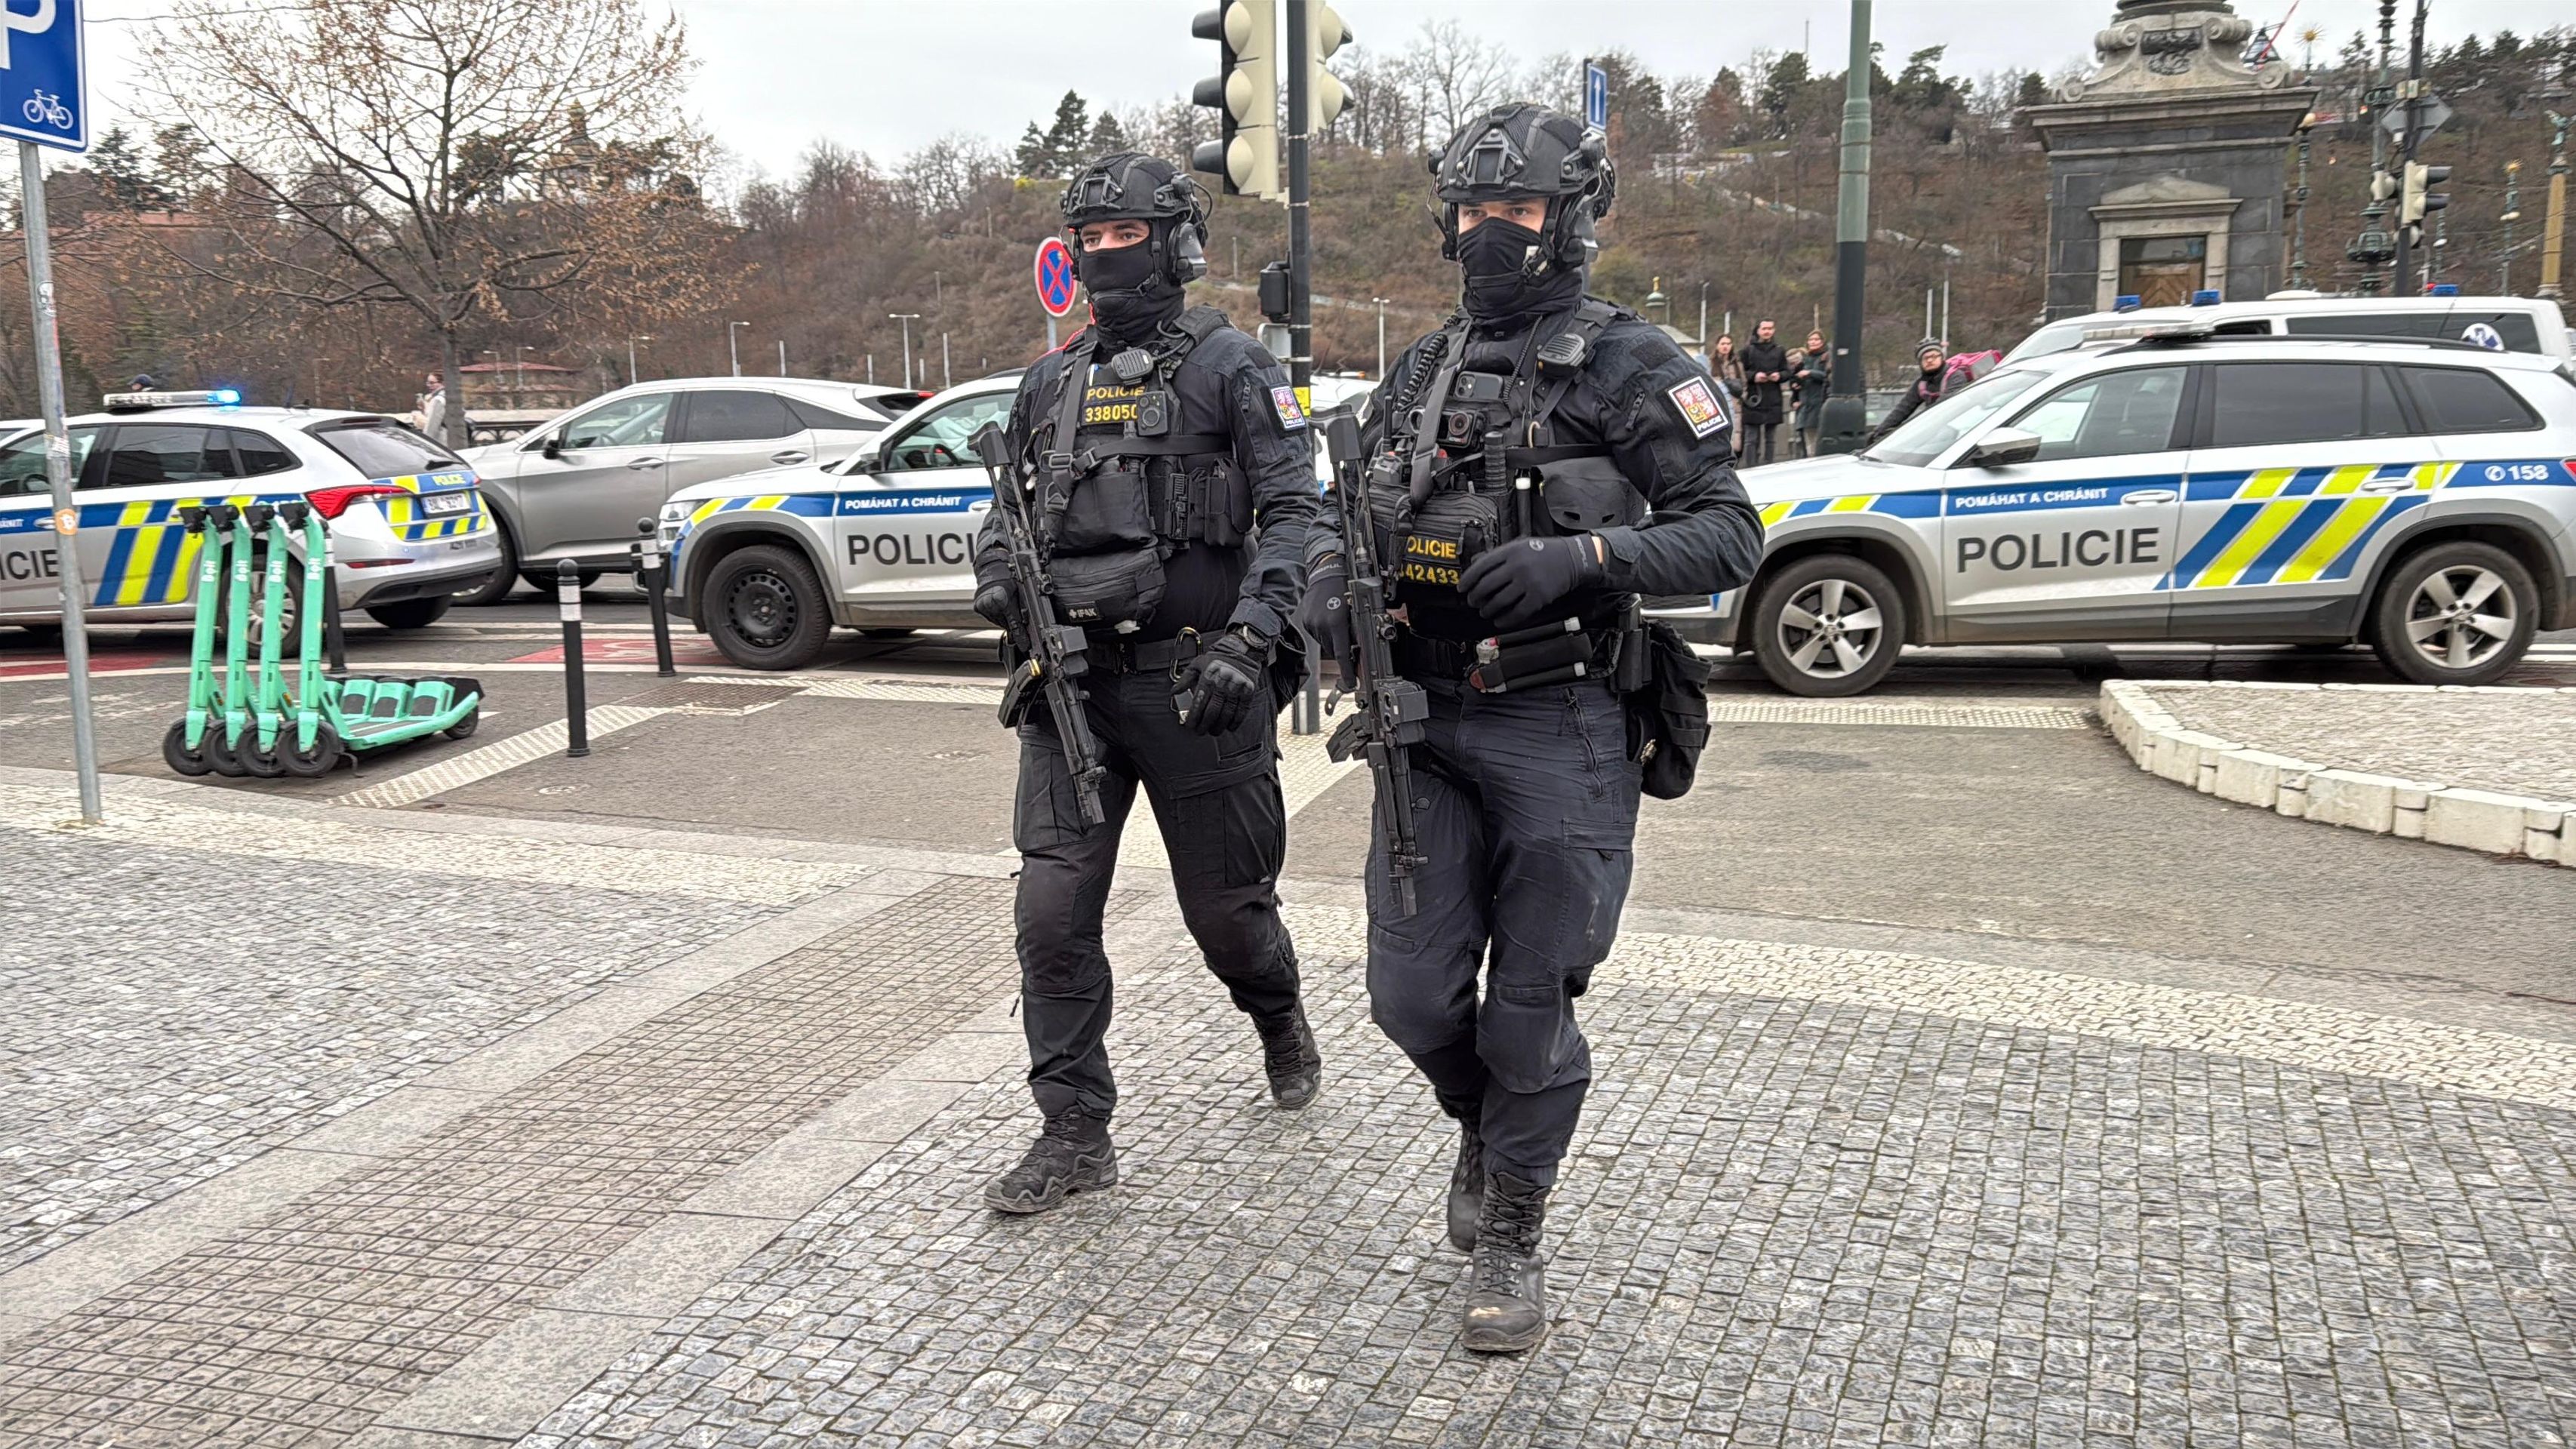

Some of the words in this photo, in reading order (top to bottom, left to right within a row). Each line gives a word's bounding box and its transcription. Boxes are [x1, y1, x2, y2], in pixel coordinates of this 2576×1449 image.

[1086, 386, 1146, 401] POLICIE
[1696, 414, 1722, 431] POLICIE
[2507, 464, 2549, 481] 158
[845, 497, 900, 509] POMÁHAT
[900, 498, 909, 507] A
[911, 495, 962, 508] CHRÁNIT
[1955, 493, 2027, 509] POMÁHAT
[2030, 492, 2041, 503] A
[2043, 487, 2110, 502] CHRÁNIT
[847, 532, 976, 565] POLICI
[1407, 535, 1457, 558] OLICIE
[1957, 527, 2159, 574] POLICIE
[1399, 563, 1460, 585] 42433
